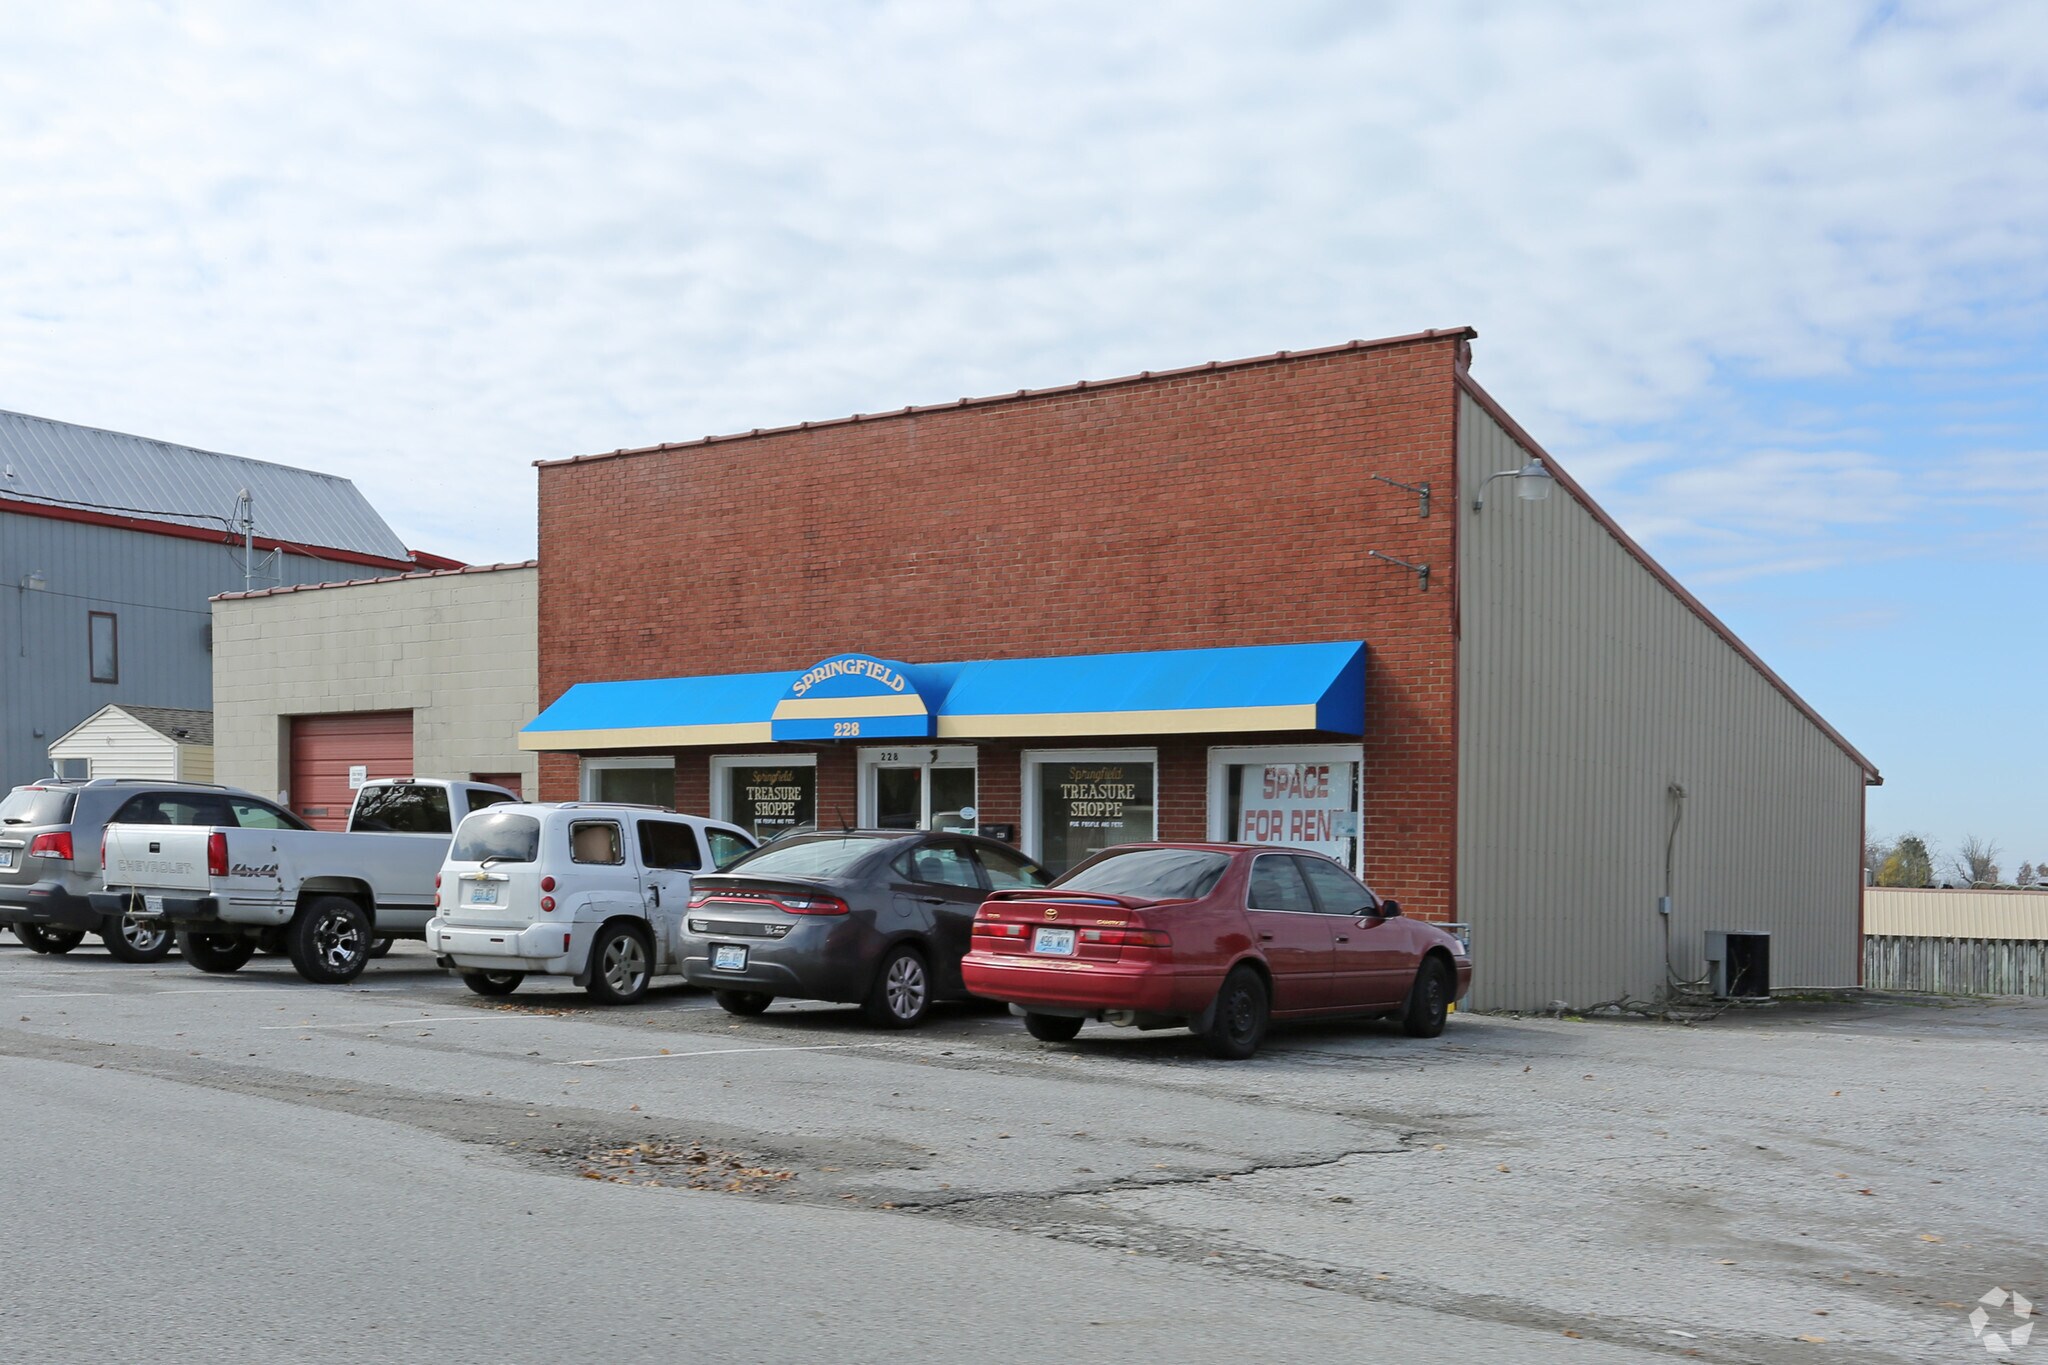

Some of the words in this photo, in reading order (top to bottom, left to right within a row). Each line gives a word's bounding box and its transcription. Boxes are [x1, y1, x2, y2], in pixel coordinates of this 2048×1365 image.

[792, 659, 905, 697] SPRINGFIELD
[833, 721, 860, 736] 228
[881, 752, 899, 761] 228
[752, 770, 794, 785] Springfield
[1069, 766, 1124, 783] Springfield
[1263, 765, 1329, 799] SPACE
[746, 786, 801, 800] TREASURE
[1060, 783, 1135, 799] TREASURE
[755, 801, 795, 816] SHOPPE
[1070, 801, 1122, 817] SHOPPE
[1244, 809, 1283, 841] FOR
[1290, 809, 1344, 841] REN
[118, 860, 191, 875] CHEVROLET
[231, 863, 278, 878] 4x4
